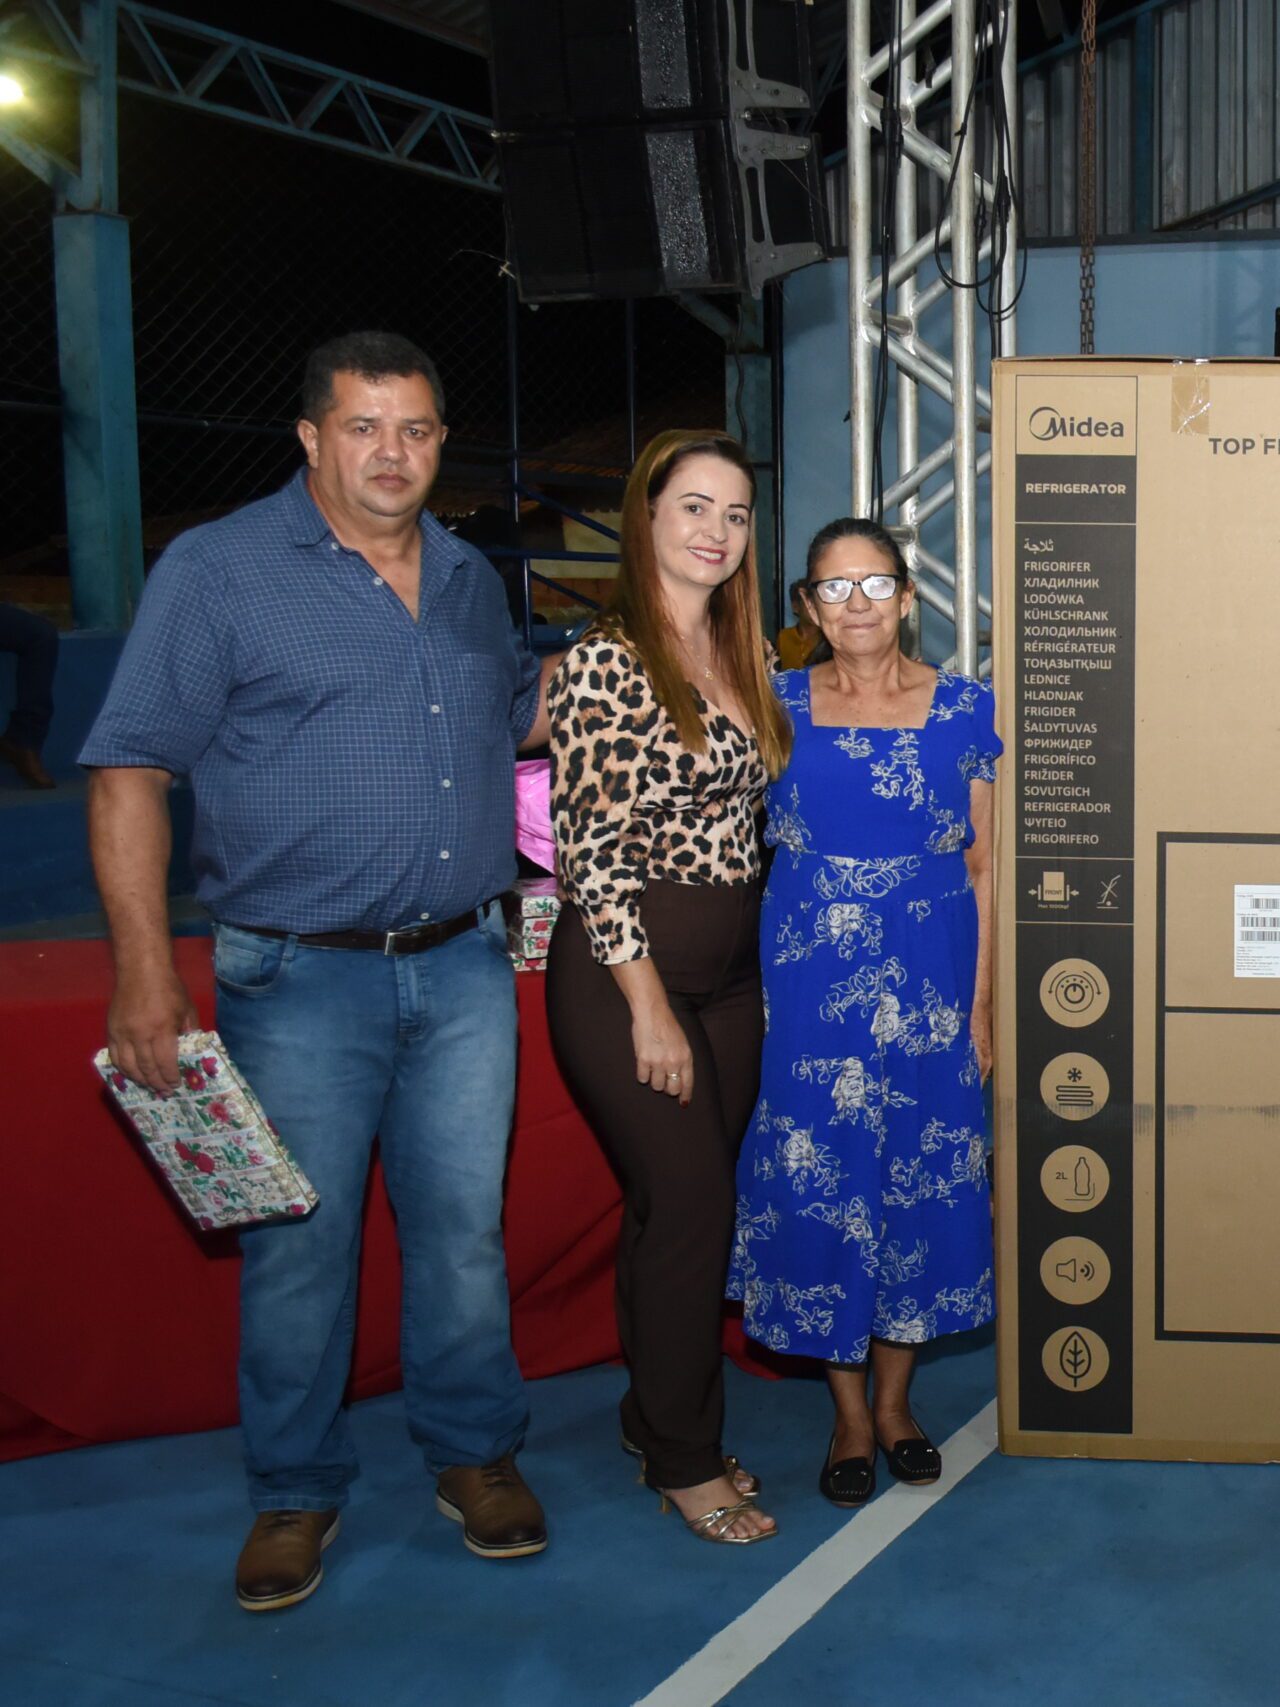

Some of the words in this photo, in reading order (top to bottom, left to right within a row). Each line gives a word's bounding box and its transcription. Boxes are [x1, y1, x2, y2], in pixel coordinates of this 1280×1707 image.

[1029, 406, 1124, 441] Midea
[1208, 438, 1256, 455] TOP
[1025, 482, 1127, 495] REFRIGERATOR
[1023, 537, 1054, 555] ثلاجة
[1024, 561, 1091, 573] FRIGORIFER
[1024, 577, 1100, 590] ХЛАДИЛНИК
[1024, 592, 1085, 605] LODÓWKA
[1024, 607, 1109, 621] KÜHLSCHRANK
[1024, 625, 1117, 639] ХОЛОДИЛЬНИК
[1024, 640, 1116, 653] RÉFRIGÉRATEUR
[1024, 658, 1112, 671] ТОҢАЗЫТҚЫШ
[1024, 674, 1071, 685] LEDNICE
[1024, 690, 1084, 701] HLADNJAK
[1024, 706, 1076, 717] FRIGIDER
[1024, 720, 1097, 733] ŠALDYTUVAS
[1024, 738, 1092, 751] ФРИЖИДЕР
[1024, 752, 1096, 765] FRIGORÍFICO
[1024, 768, 1074, 781] FRIŽIDER
[1024, 786, 1090, 797] SOVUTGICH
[1024, 802, 1111, 813] REFRIGERADOR
[1024, 833, 1099, 845] FRIGORIFERO
[1055, 1171, 1068, 1180] 2L
